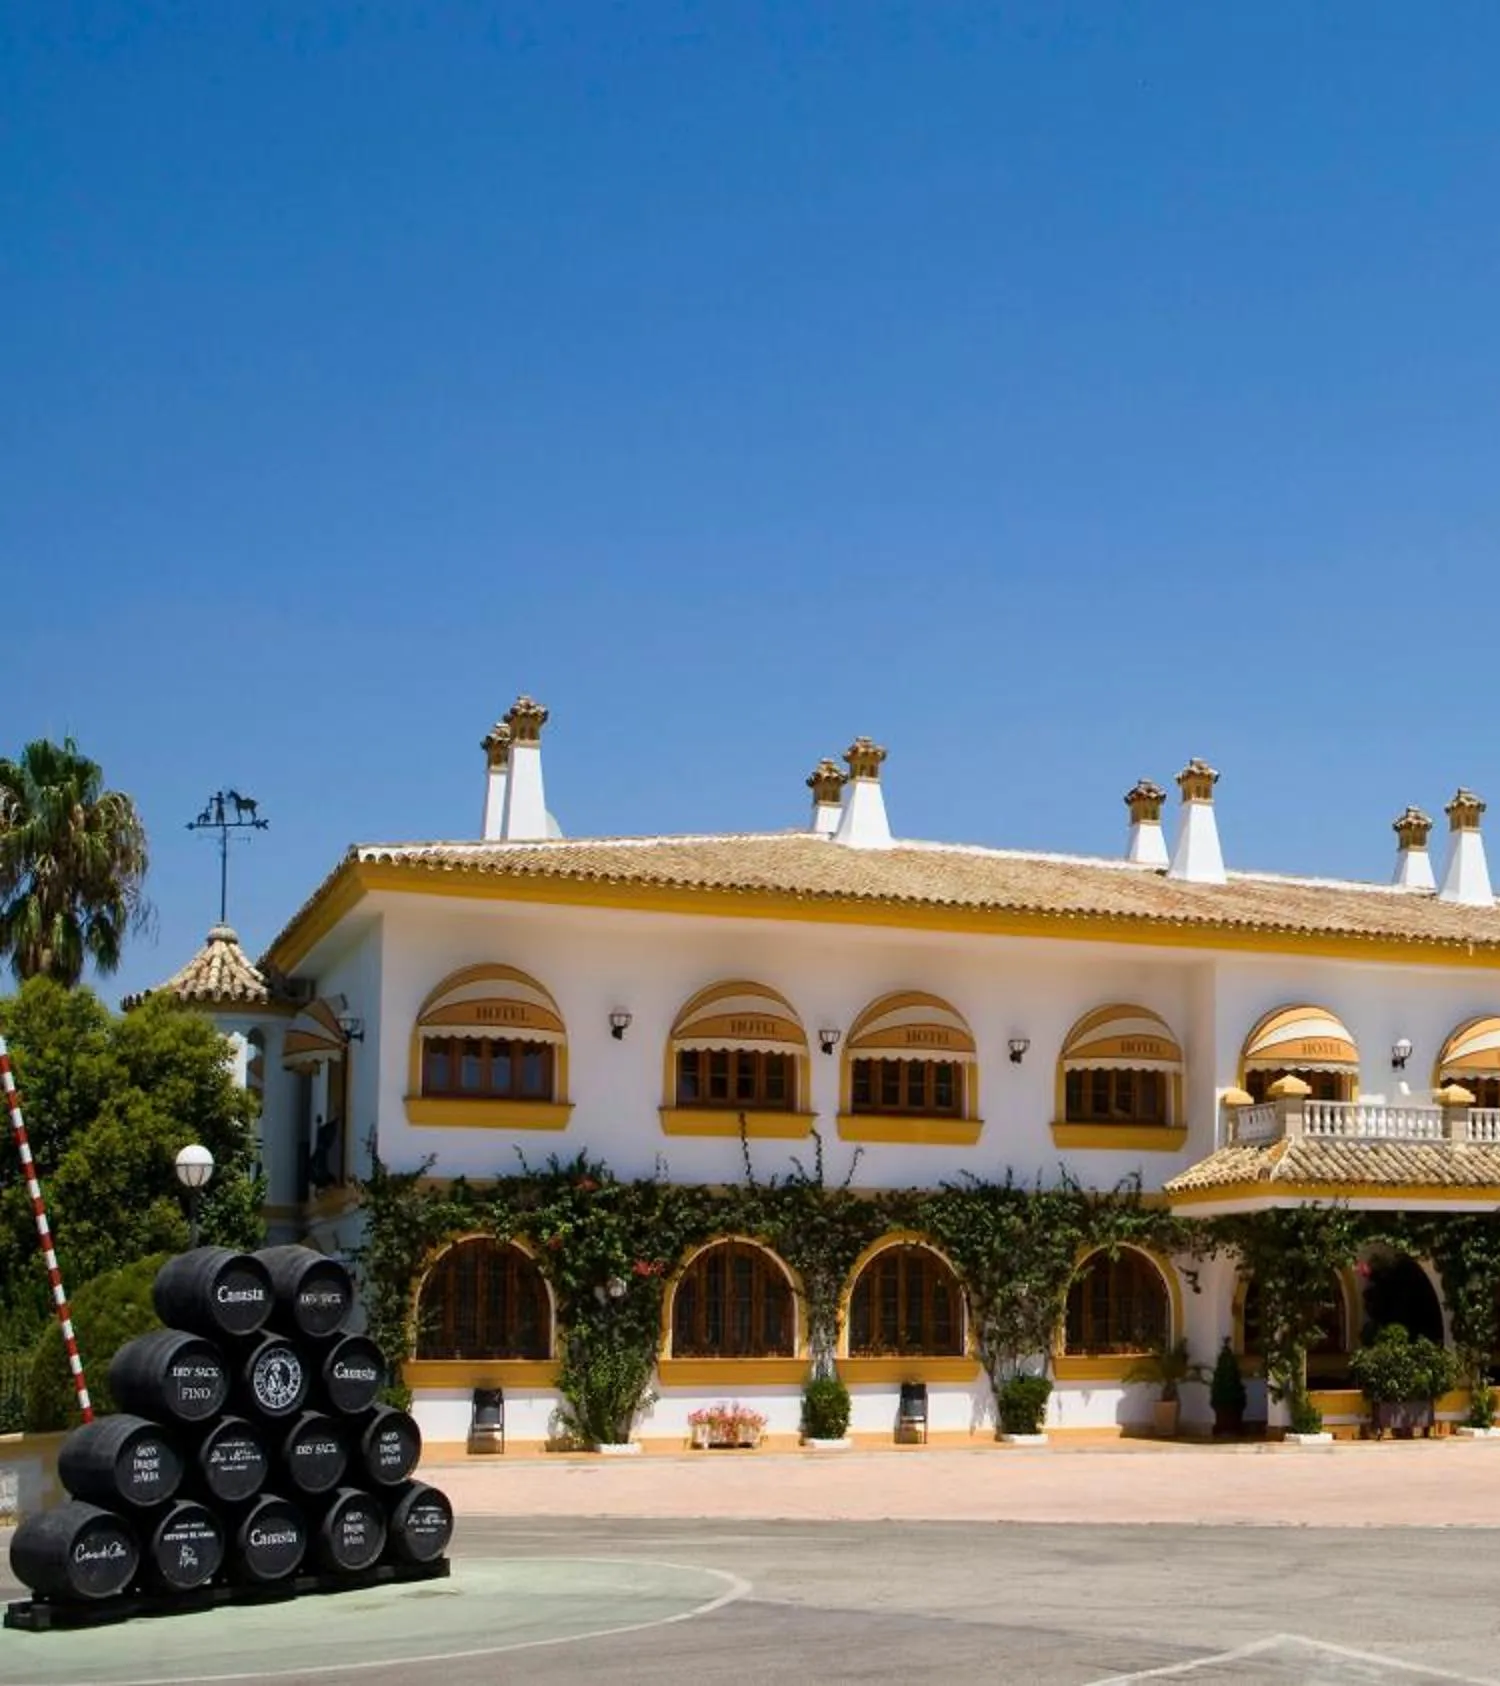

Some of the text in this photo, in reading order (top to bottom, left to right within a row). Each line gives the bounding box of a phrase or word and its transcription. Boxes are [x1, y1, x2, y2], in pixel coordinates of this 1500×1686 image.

[476, 1007, 525, 1021] HOTEL
[730, 1020, 776, 1034] HOTEL
[906, 1030, 949, 1043] HOTEL
[1120, 1040, 1161, 1053] HOTEL
[1302, 1041, 1342, 1055] HOTEL
[217, 1285, 265, 1303] Canasta
[172, 1366, 220, 1377] DRY SACK
[181, 1387, 211, 1400] FINO
[250, 1528, 297, 1547] Canasta
